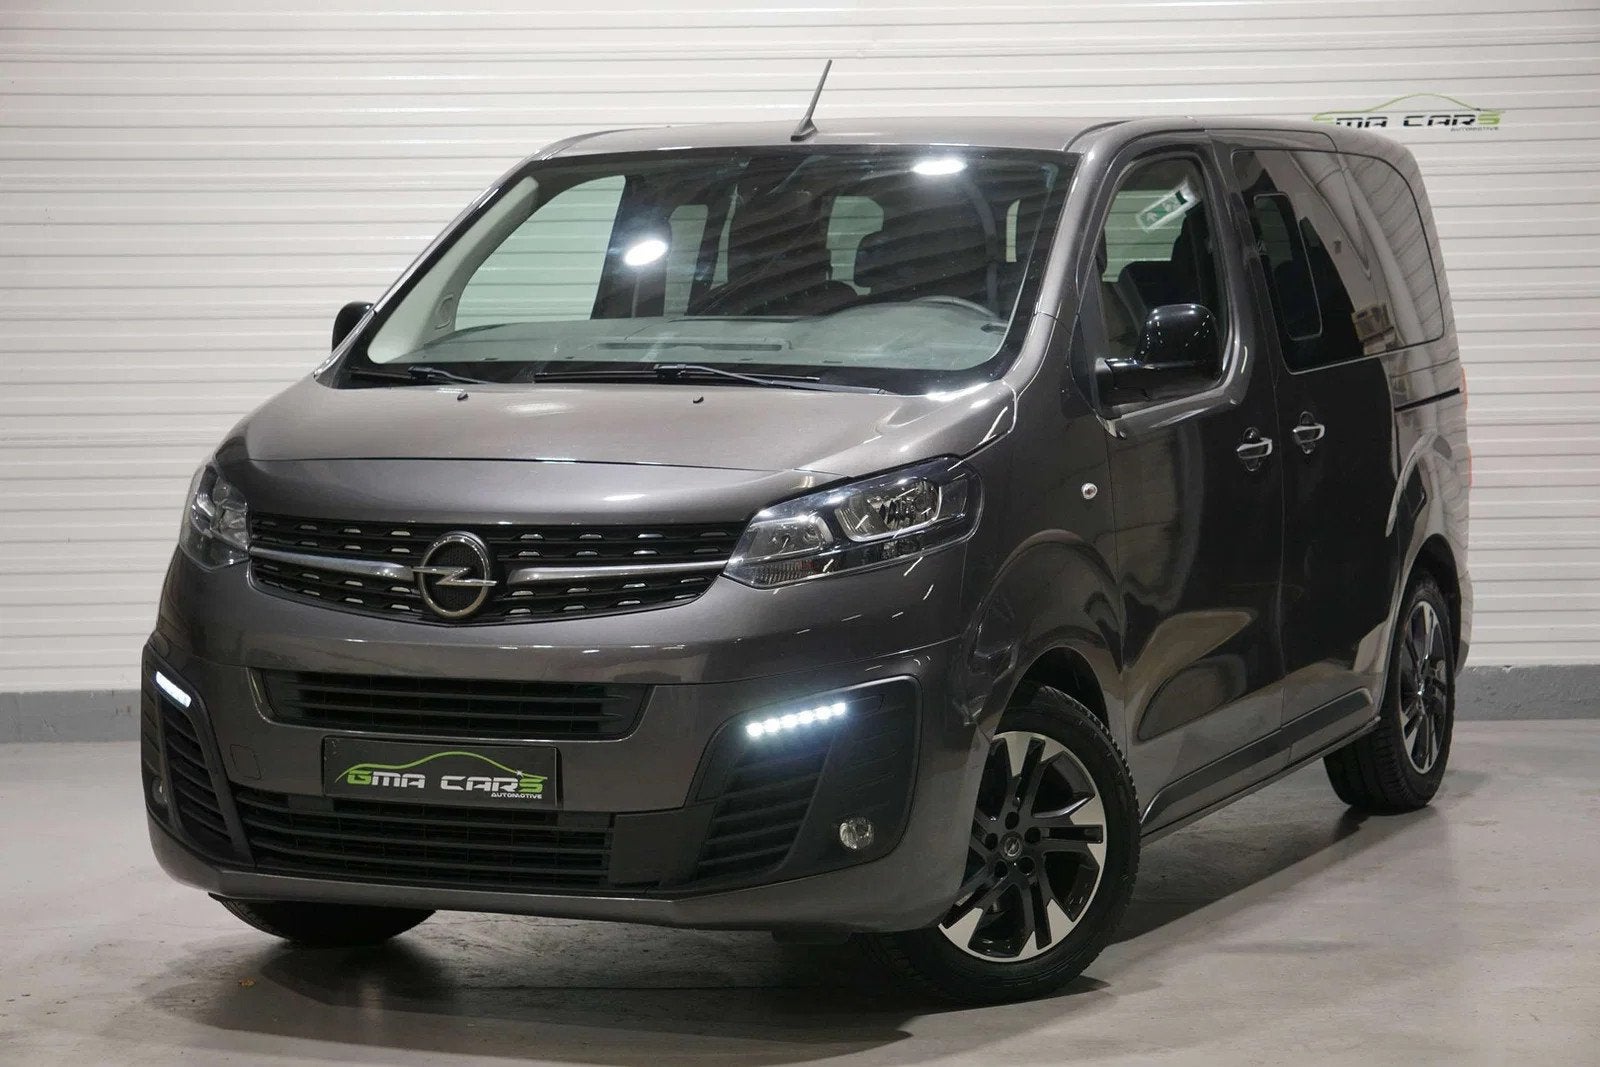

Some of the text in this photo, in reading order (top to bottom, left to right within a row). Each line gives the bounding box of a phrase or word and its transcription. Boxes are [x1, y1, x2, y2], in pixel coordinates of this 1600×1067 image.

[1403, 113, 1500, 127] CARS
[347, 769, 544, 793] GMA CARS
